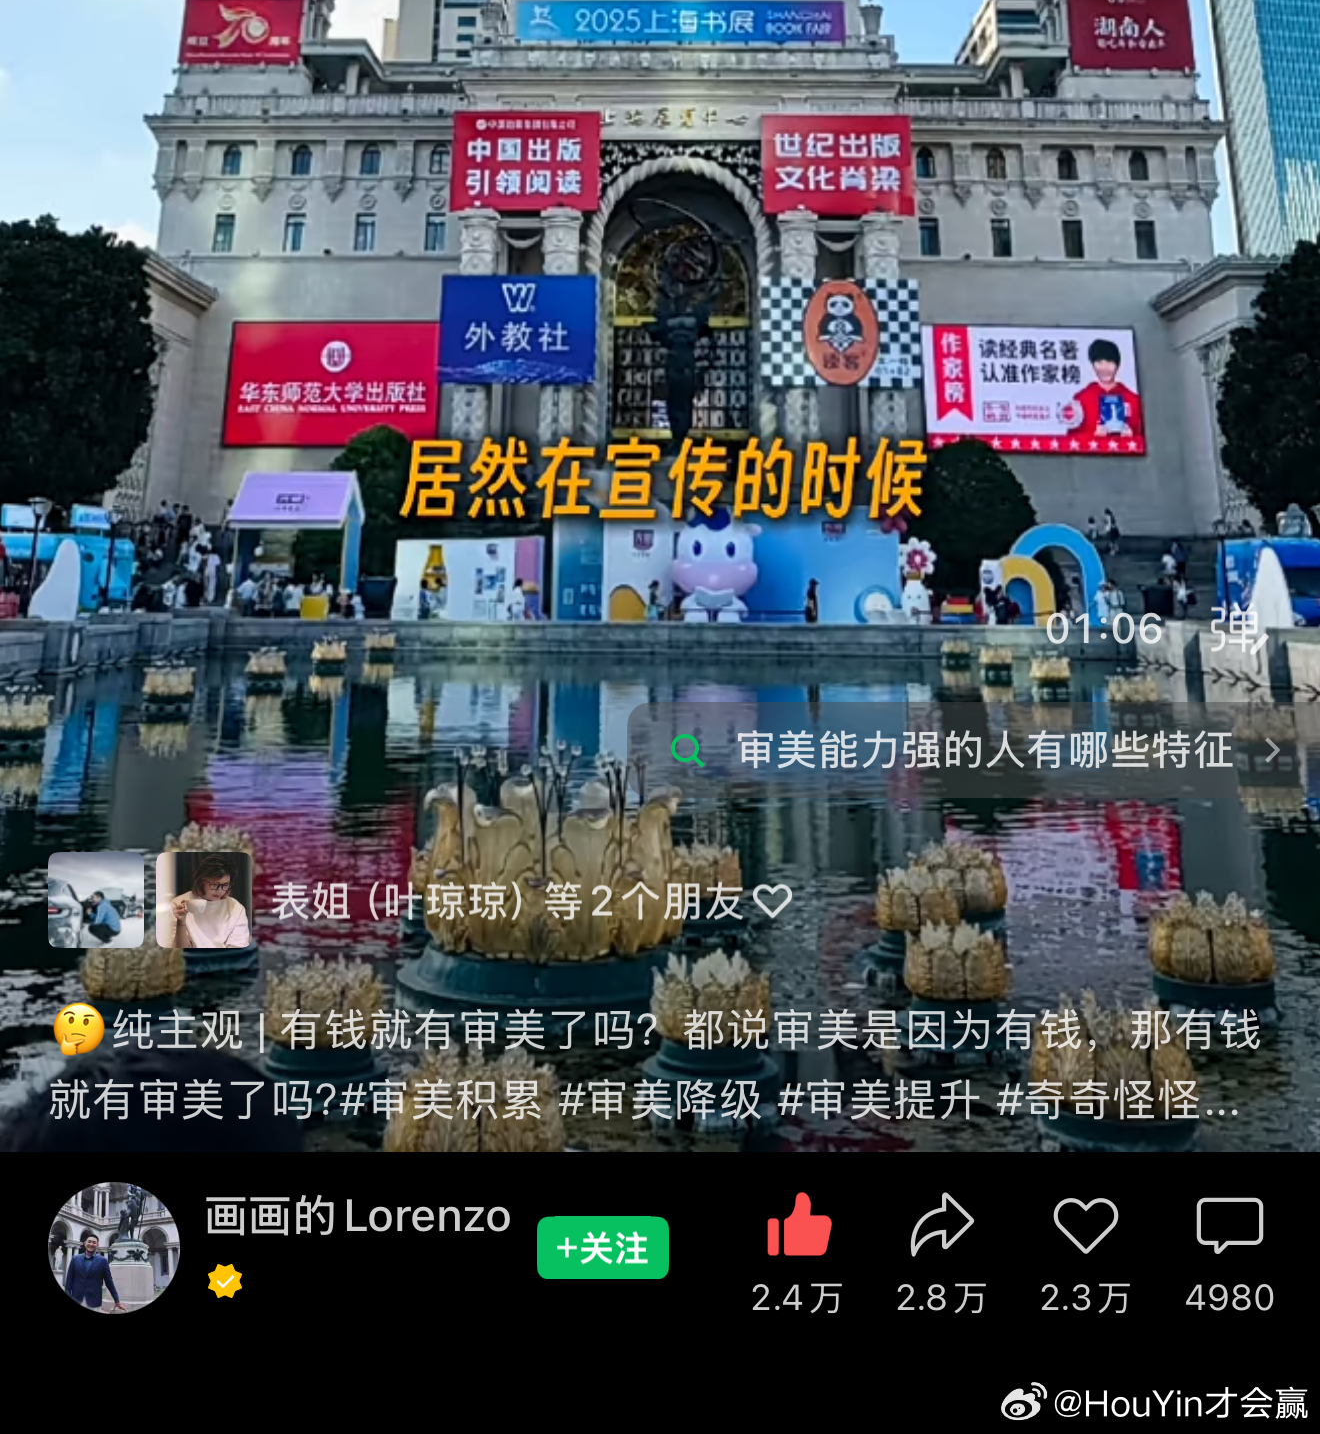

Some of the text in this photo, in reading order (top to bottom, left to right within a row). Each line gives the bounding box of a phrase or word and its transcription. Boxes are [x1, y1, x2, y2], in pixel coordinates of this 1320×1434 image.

[1093, 15, 1166, 38] 湖南人
[466, 137, 583, 163] 中国出版
[772, 132, 902, 160] 世纪出版
[465, 169, 583, 197] 引领阅读
[464, 321, 570, 353] 外教社
[978, 339, 1080, 361] 读经典名著
[940, 332, 965, 404] 作家榜
[980, 362, 1082, 385] 认准作家榜
[239, 381, 427, 403] 华东师范大学出版社
[341, 404, 396, 414] UNIVERSITY
